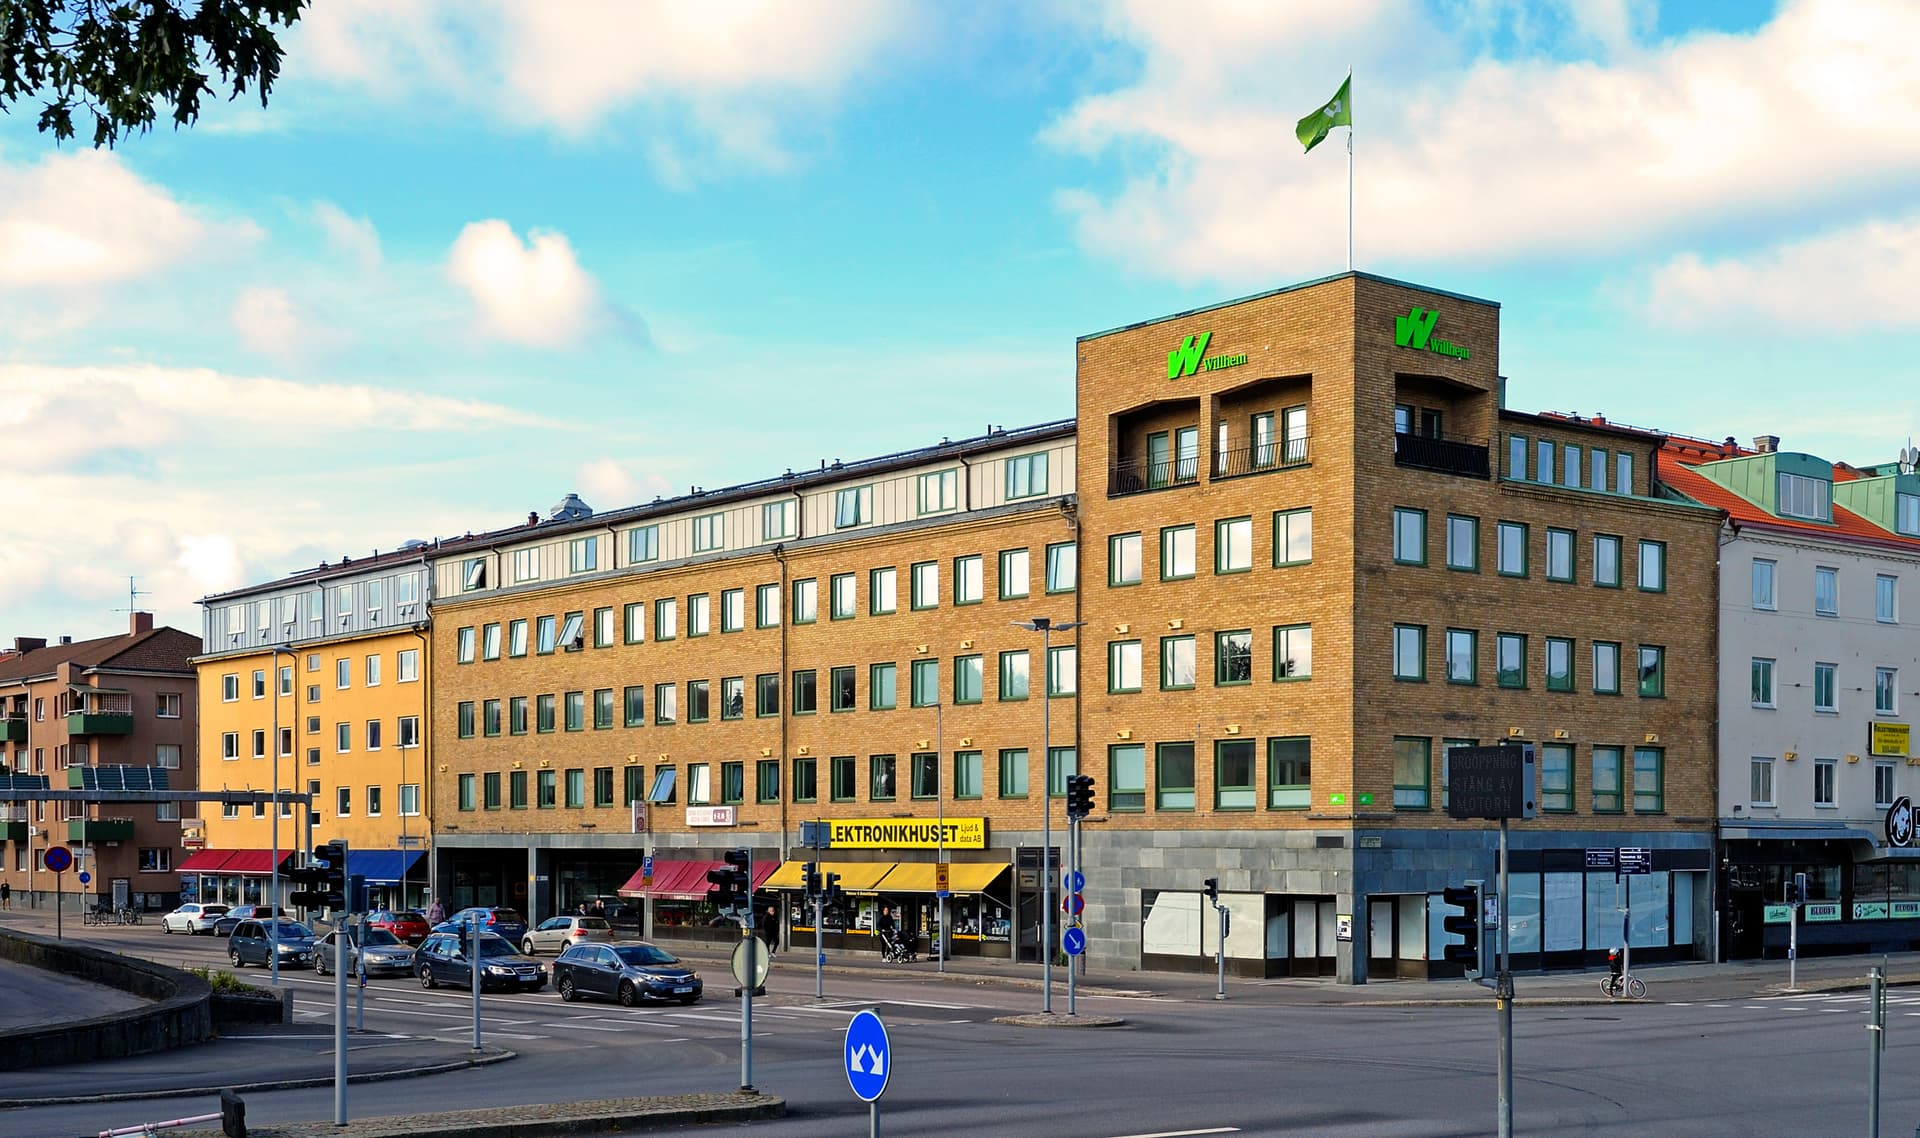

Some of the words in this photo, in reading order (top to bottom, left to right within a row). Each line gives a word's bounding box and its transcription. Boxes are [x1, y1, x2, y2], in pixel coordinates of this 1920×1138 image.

[1430, 338, 1471, 359] Willhem
[1203, 353, 1248, 371] Willhem
[1456, 796, 1512, 812] MOTORN
[961, 824, 974, 834] Ljud
[960, 834, 973, 843] data
[973, 834, 982, 842] AB
